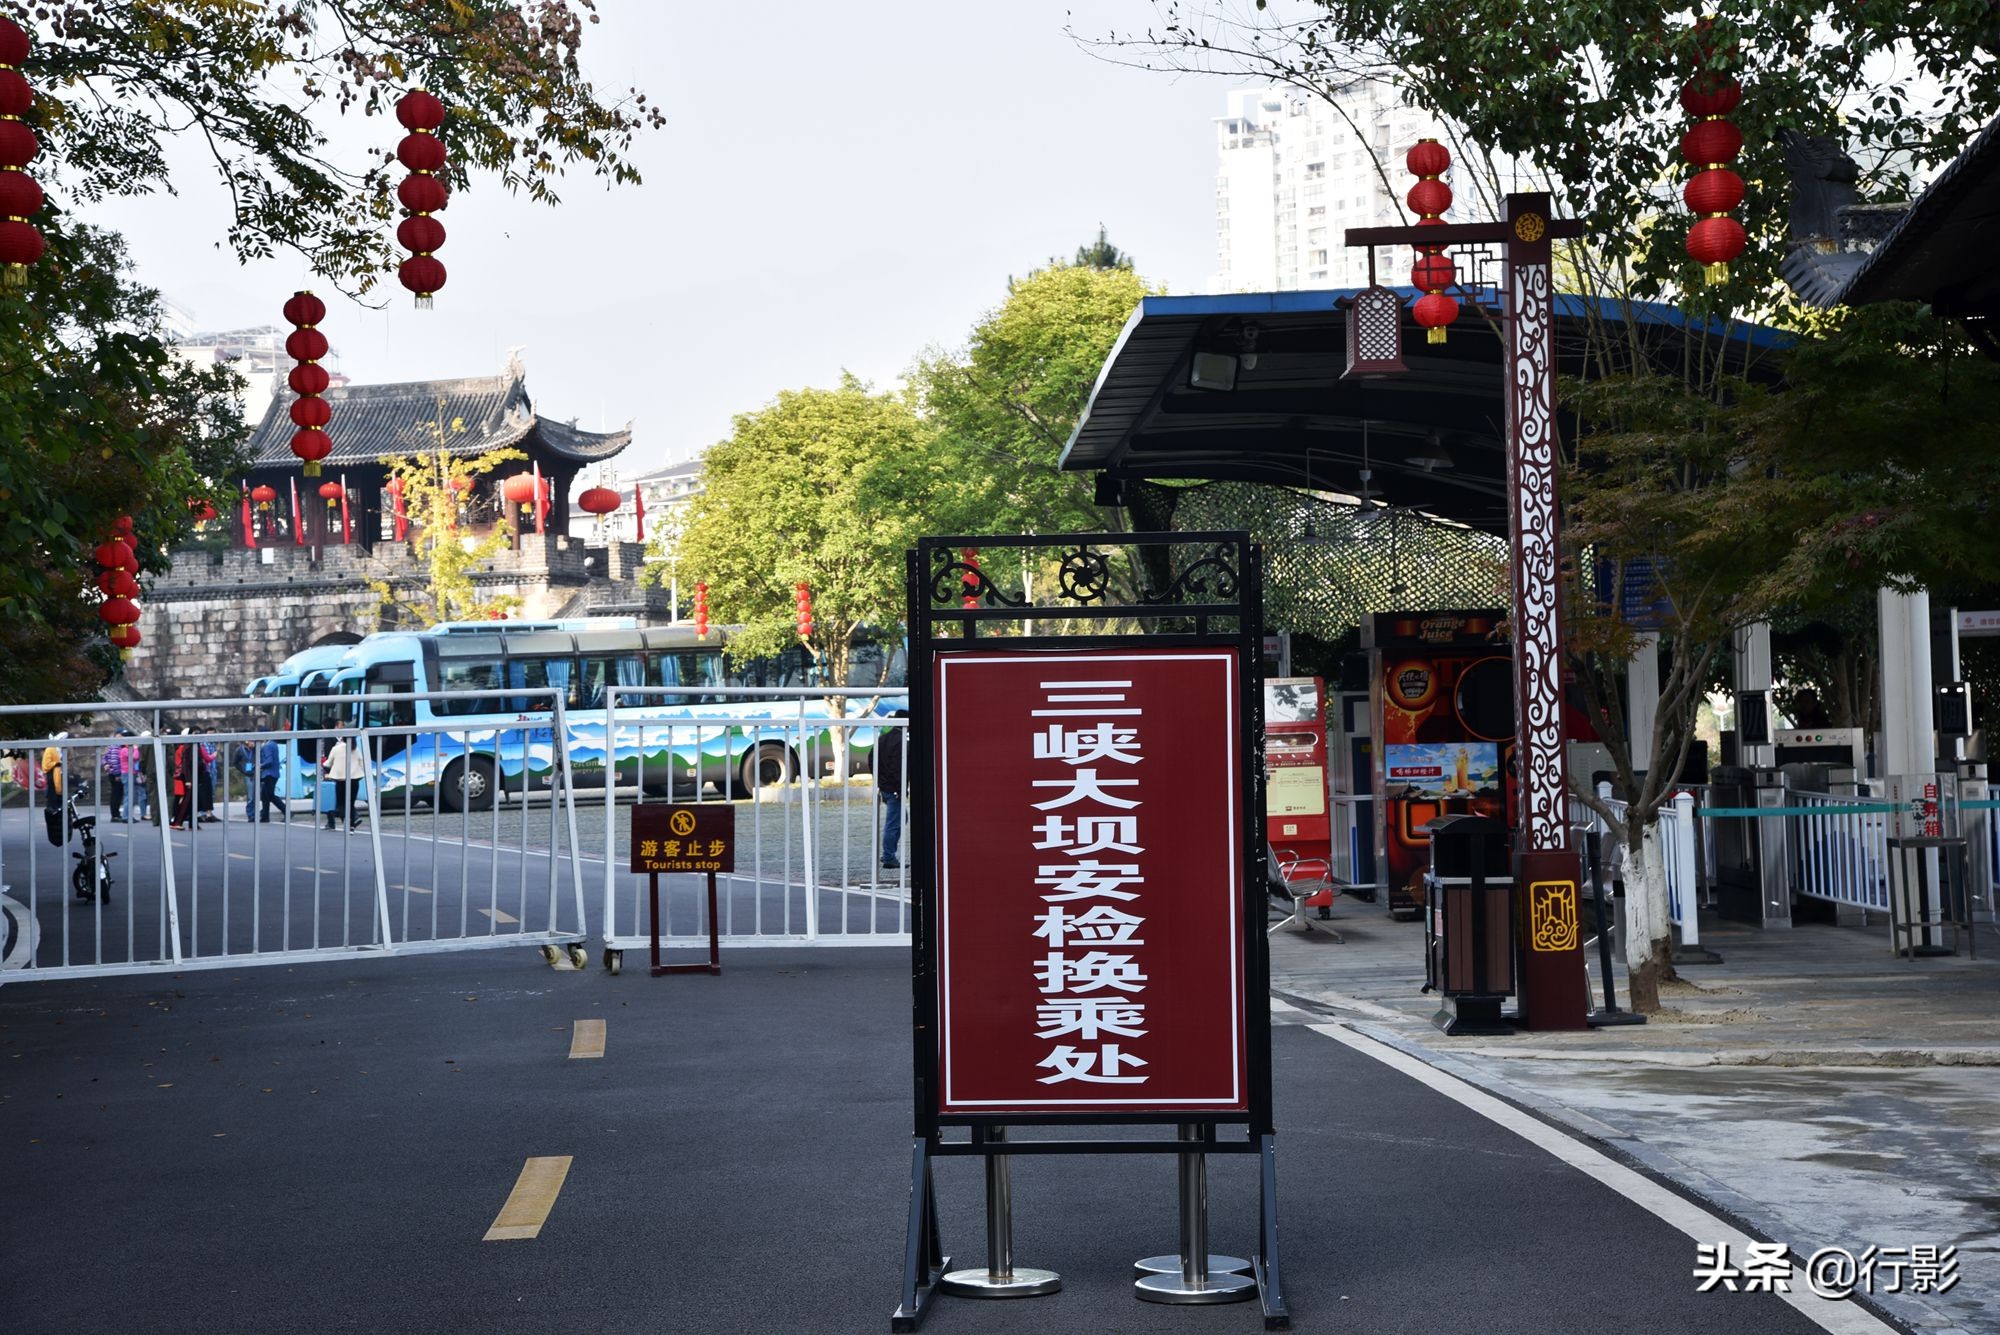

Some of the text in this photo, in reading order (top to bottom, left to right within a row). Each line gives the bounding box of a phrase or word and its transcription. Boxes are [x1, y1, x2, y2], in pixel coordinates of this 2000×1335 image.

[1420, 617, 1466, 630] Orange
[1419, 629, 1454, 641] Juice
[640, 839, 726, 858] 游客止步
[644, 859, 721, 871] Tourists stop
[1030, 681, 1150, 1085] 三峡大坝安检换乘处
